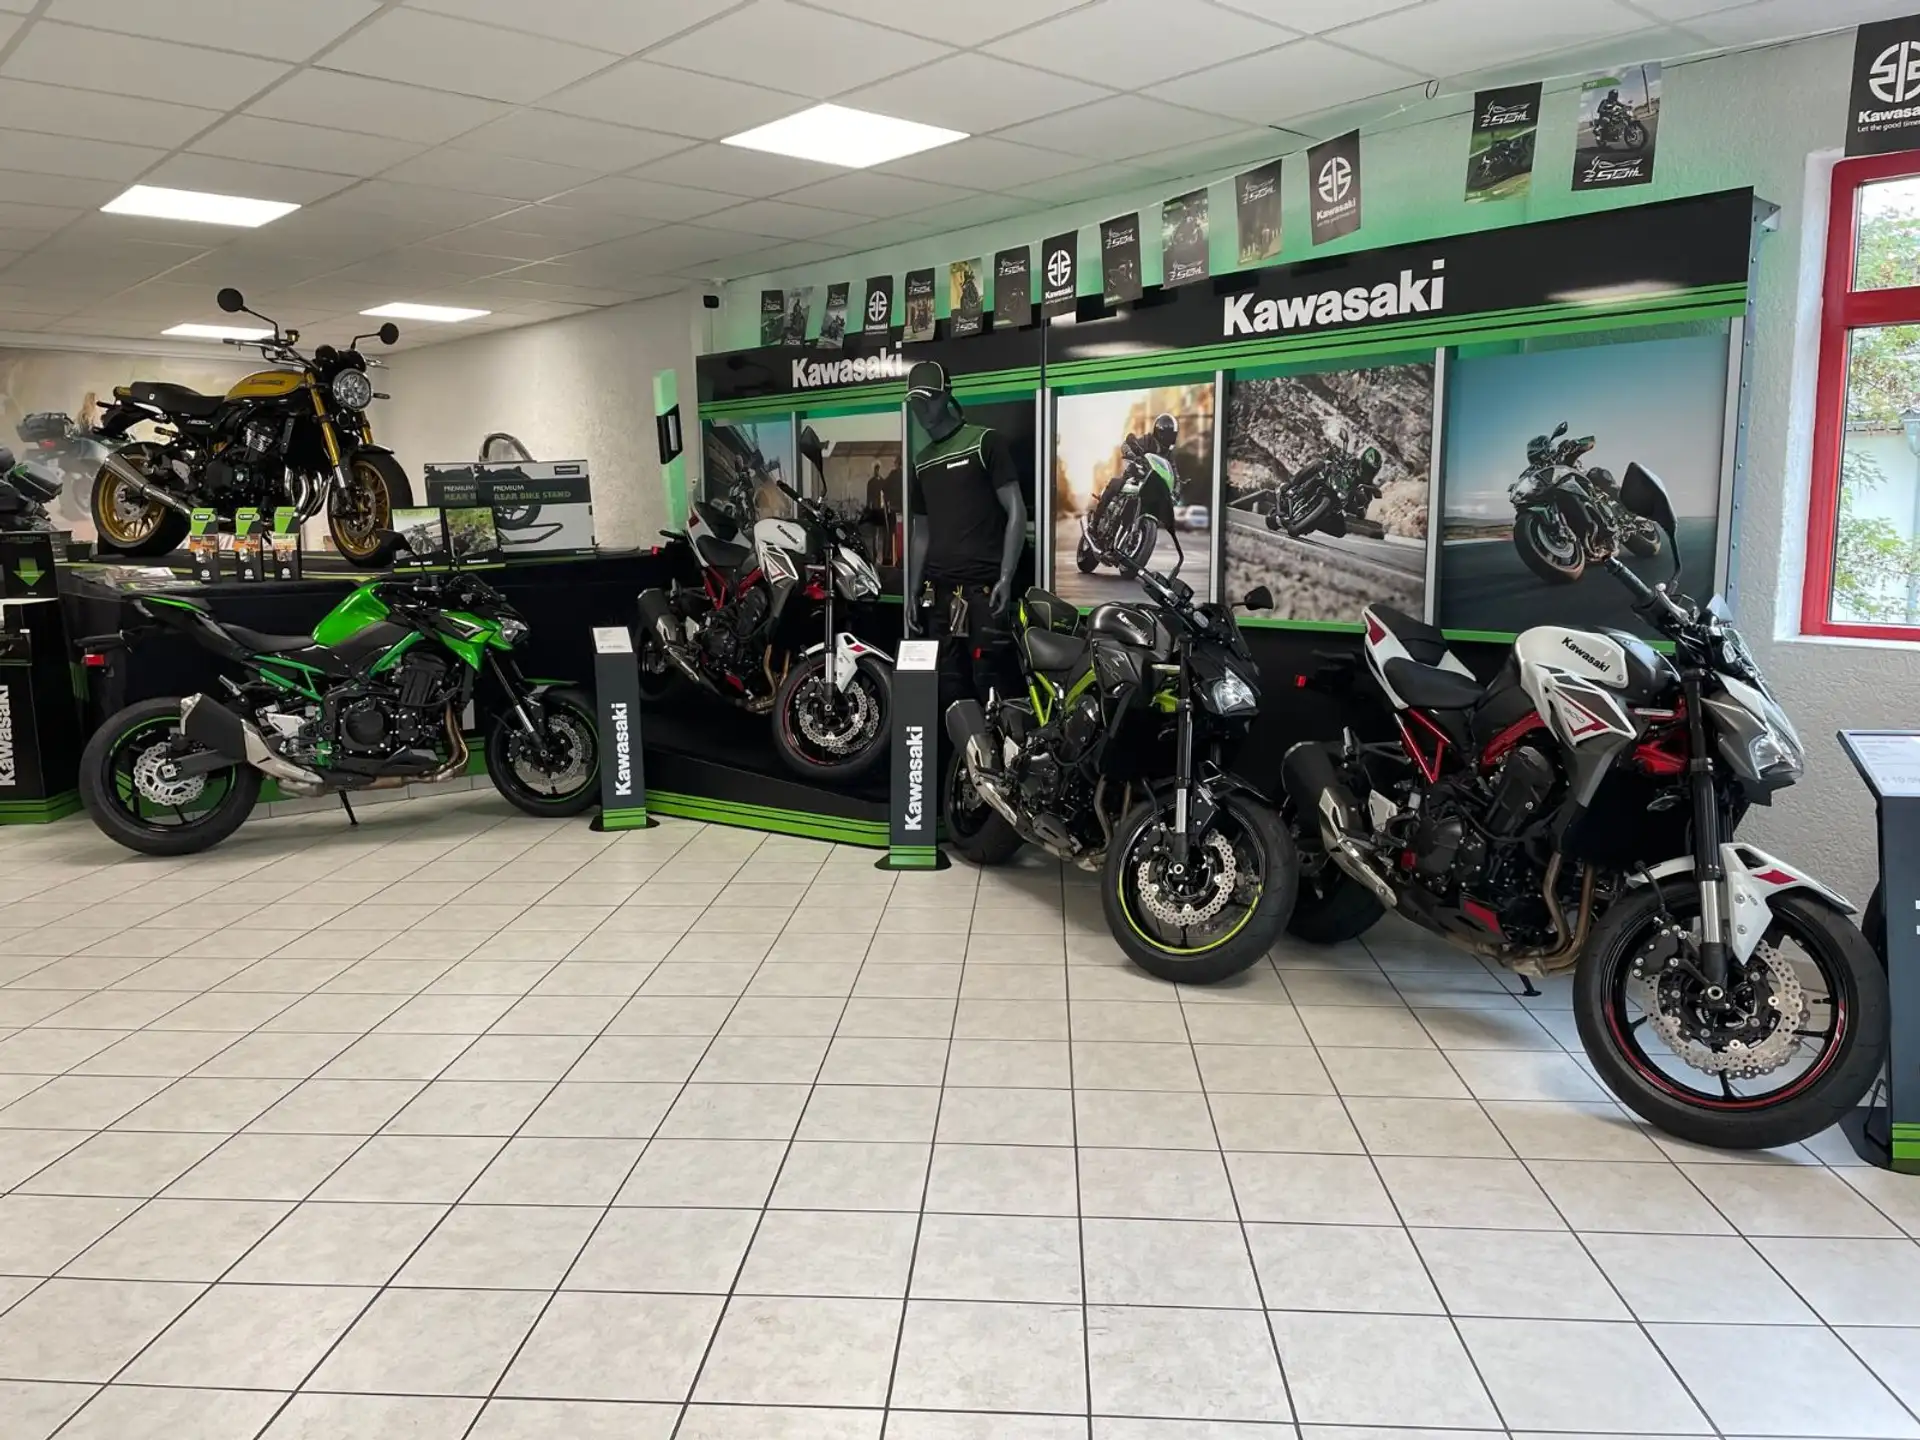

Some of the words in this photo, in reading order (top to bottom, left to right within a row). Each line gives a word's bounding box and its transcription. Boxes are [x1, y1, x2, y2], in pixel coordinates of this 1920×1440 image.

[1870, 124, 1882, 132] the
[1883, 121, 1902, 132] good
[1316, 197, 1356, 220] Kawasaki
[1045, 284, 1074, 299] Kawasaki
[1223, 258, 1445, 336] Kawasaki
[792, 341, 902, 388] Kawasaki
[493, 493, 518, 501] REAR
[519, 492, 540, 500] BIKE
[542, 490, 571, 499] STAND
[1561, 636, 1611, 673] Kawasaki
[611, 703, 632, 796] Kawasaki
[904, 726, 923, 831] Kawasaki
